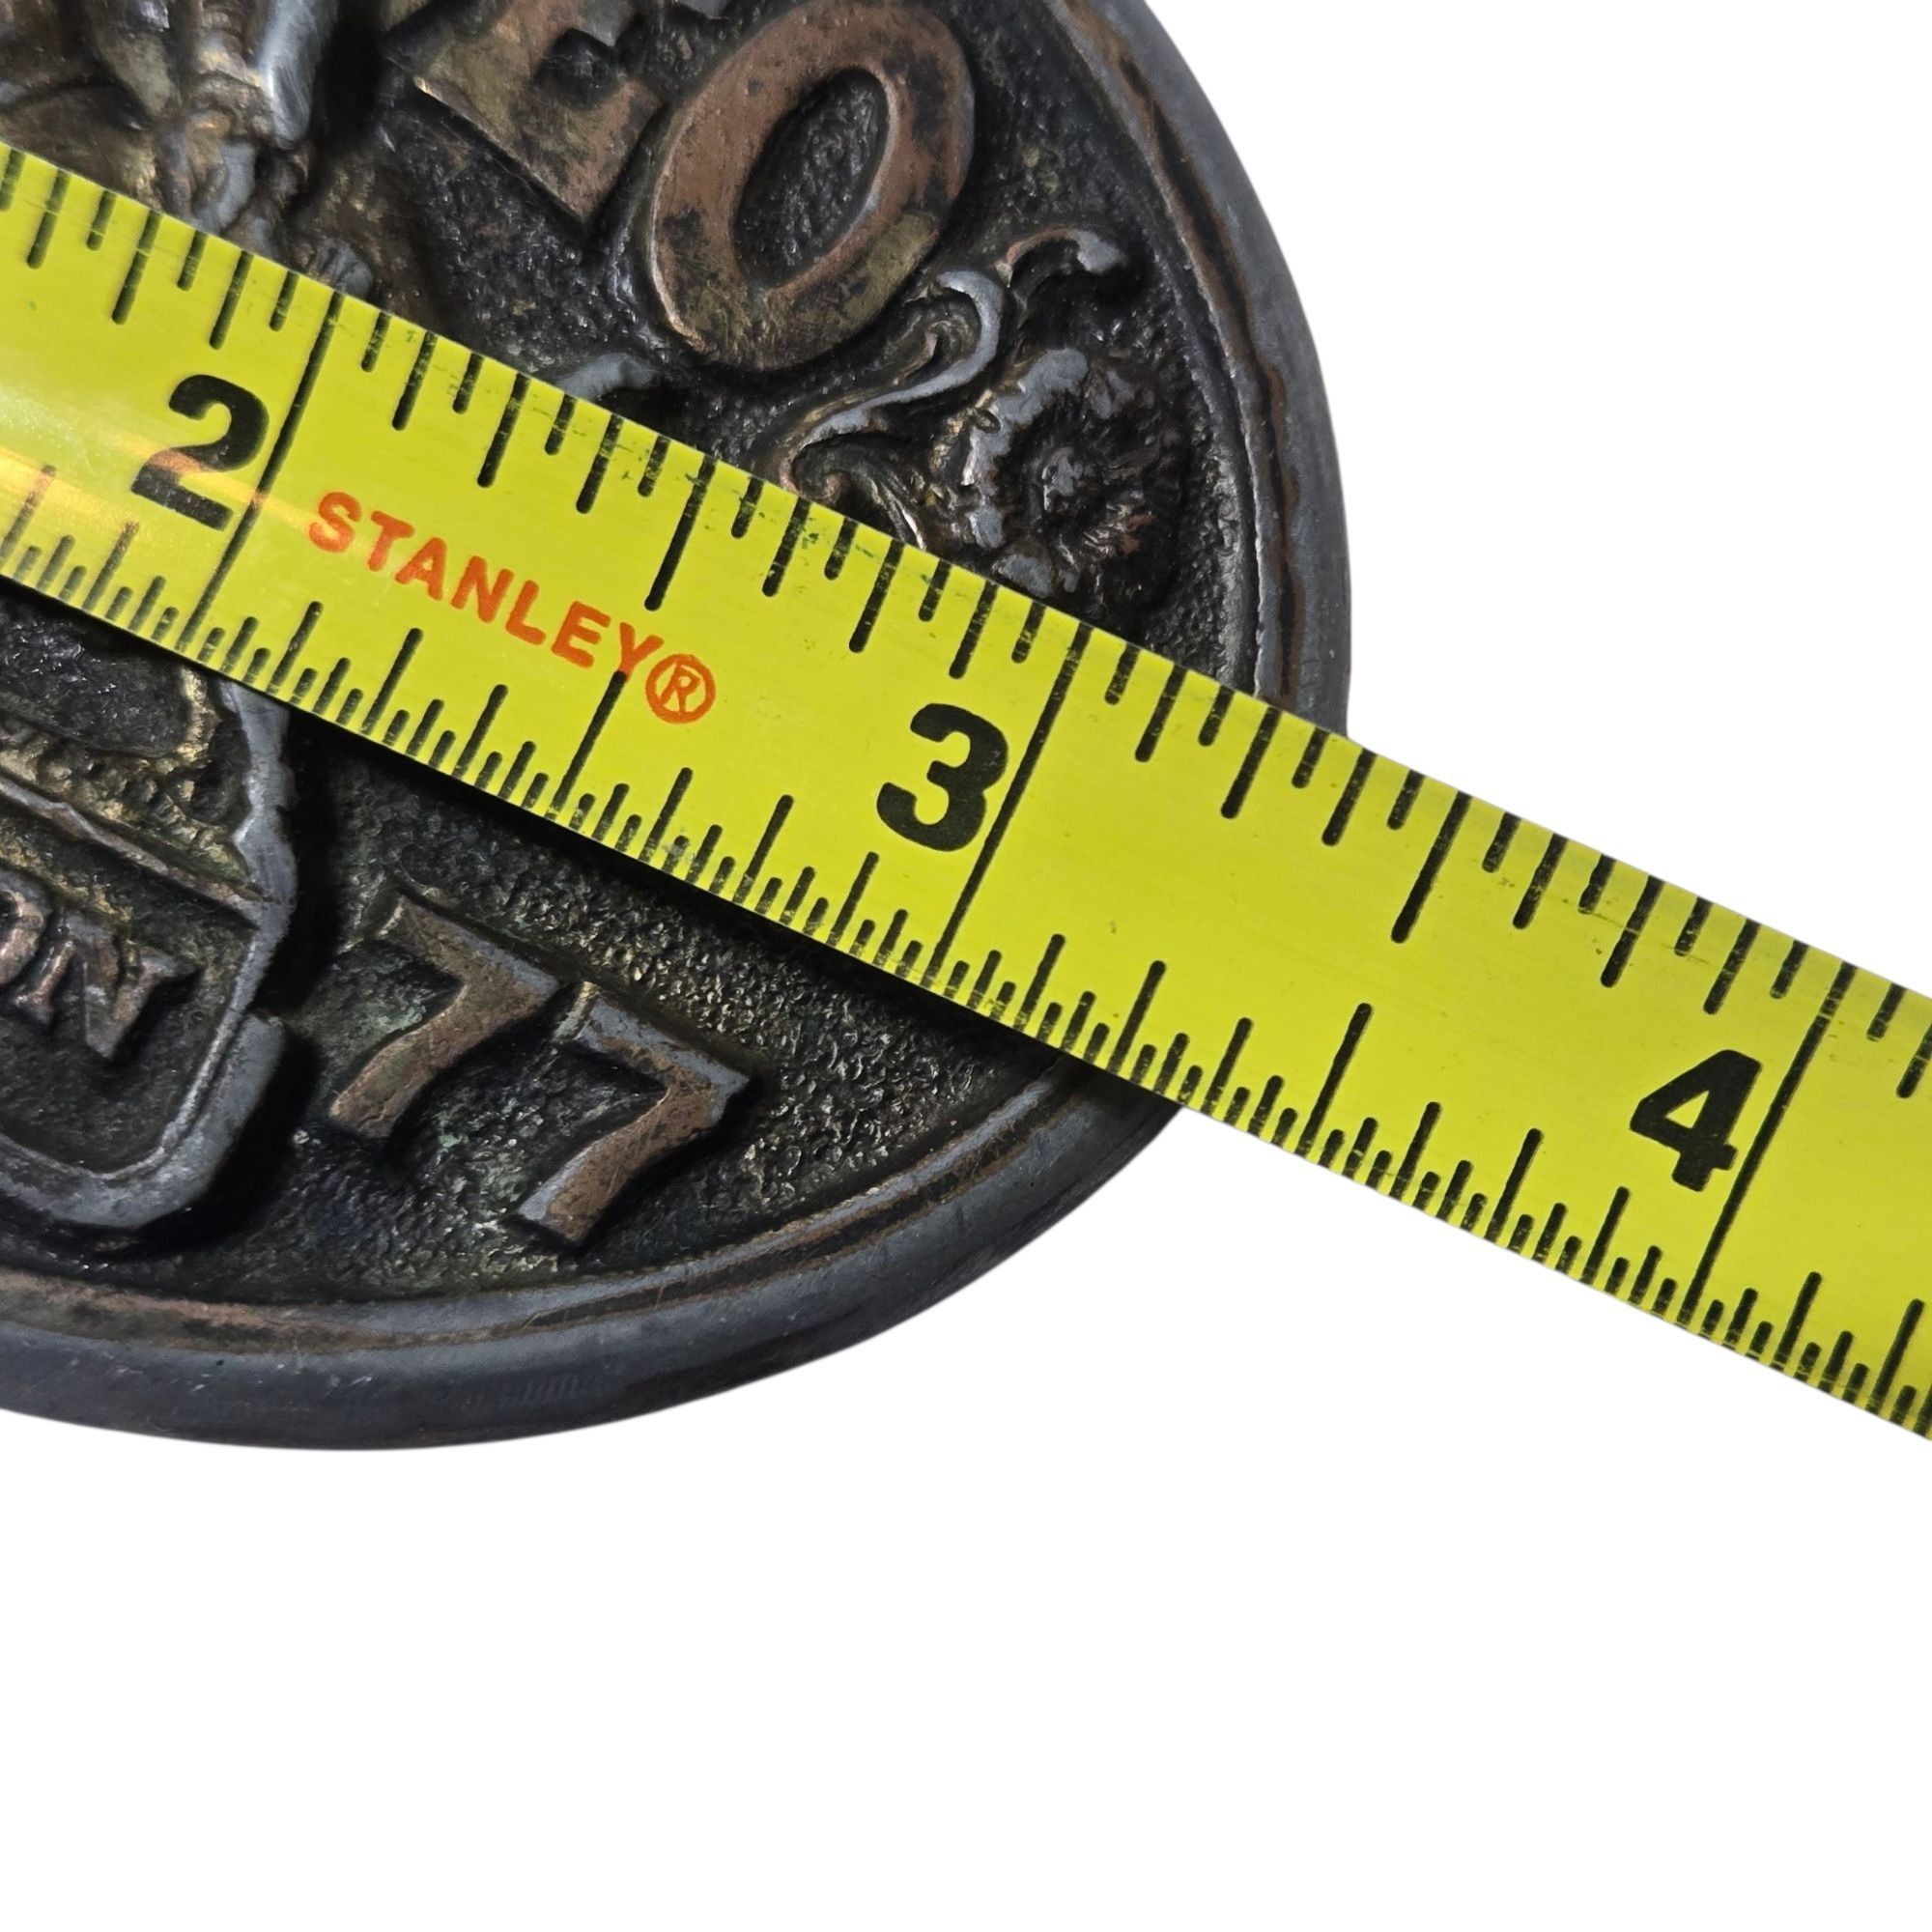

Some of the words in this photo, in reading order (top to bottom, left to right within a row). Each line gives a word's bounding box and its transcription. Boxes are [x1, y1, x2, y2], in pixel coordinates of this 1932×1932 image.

[130, 374, 270, 530] 2
[876, 702, 1009, 852] 3
[328, 895, 751, 1245] 77
[1629, 1049, 1762, 1192] 4
